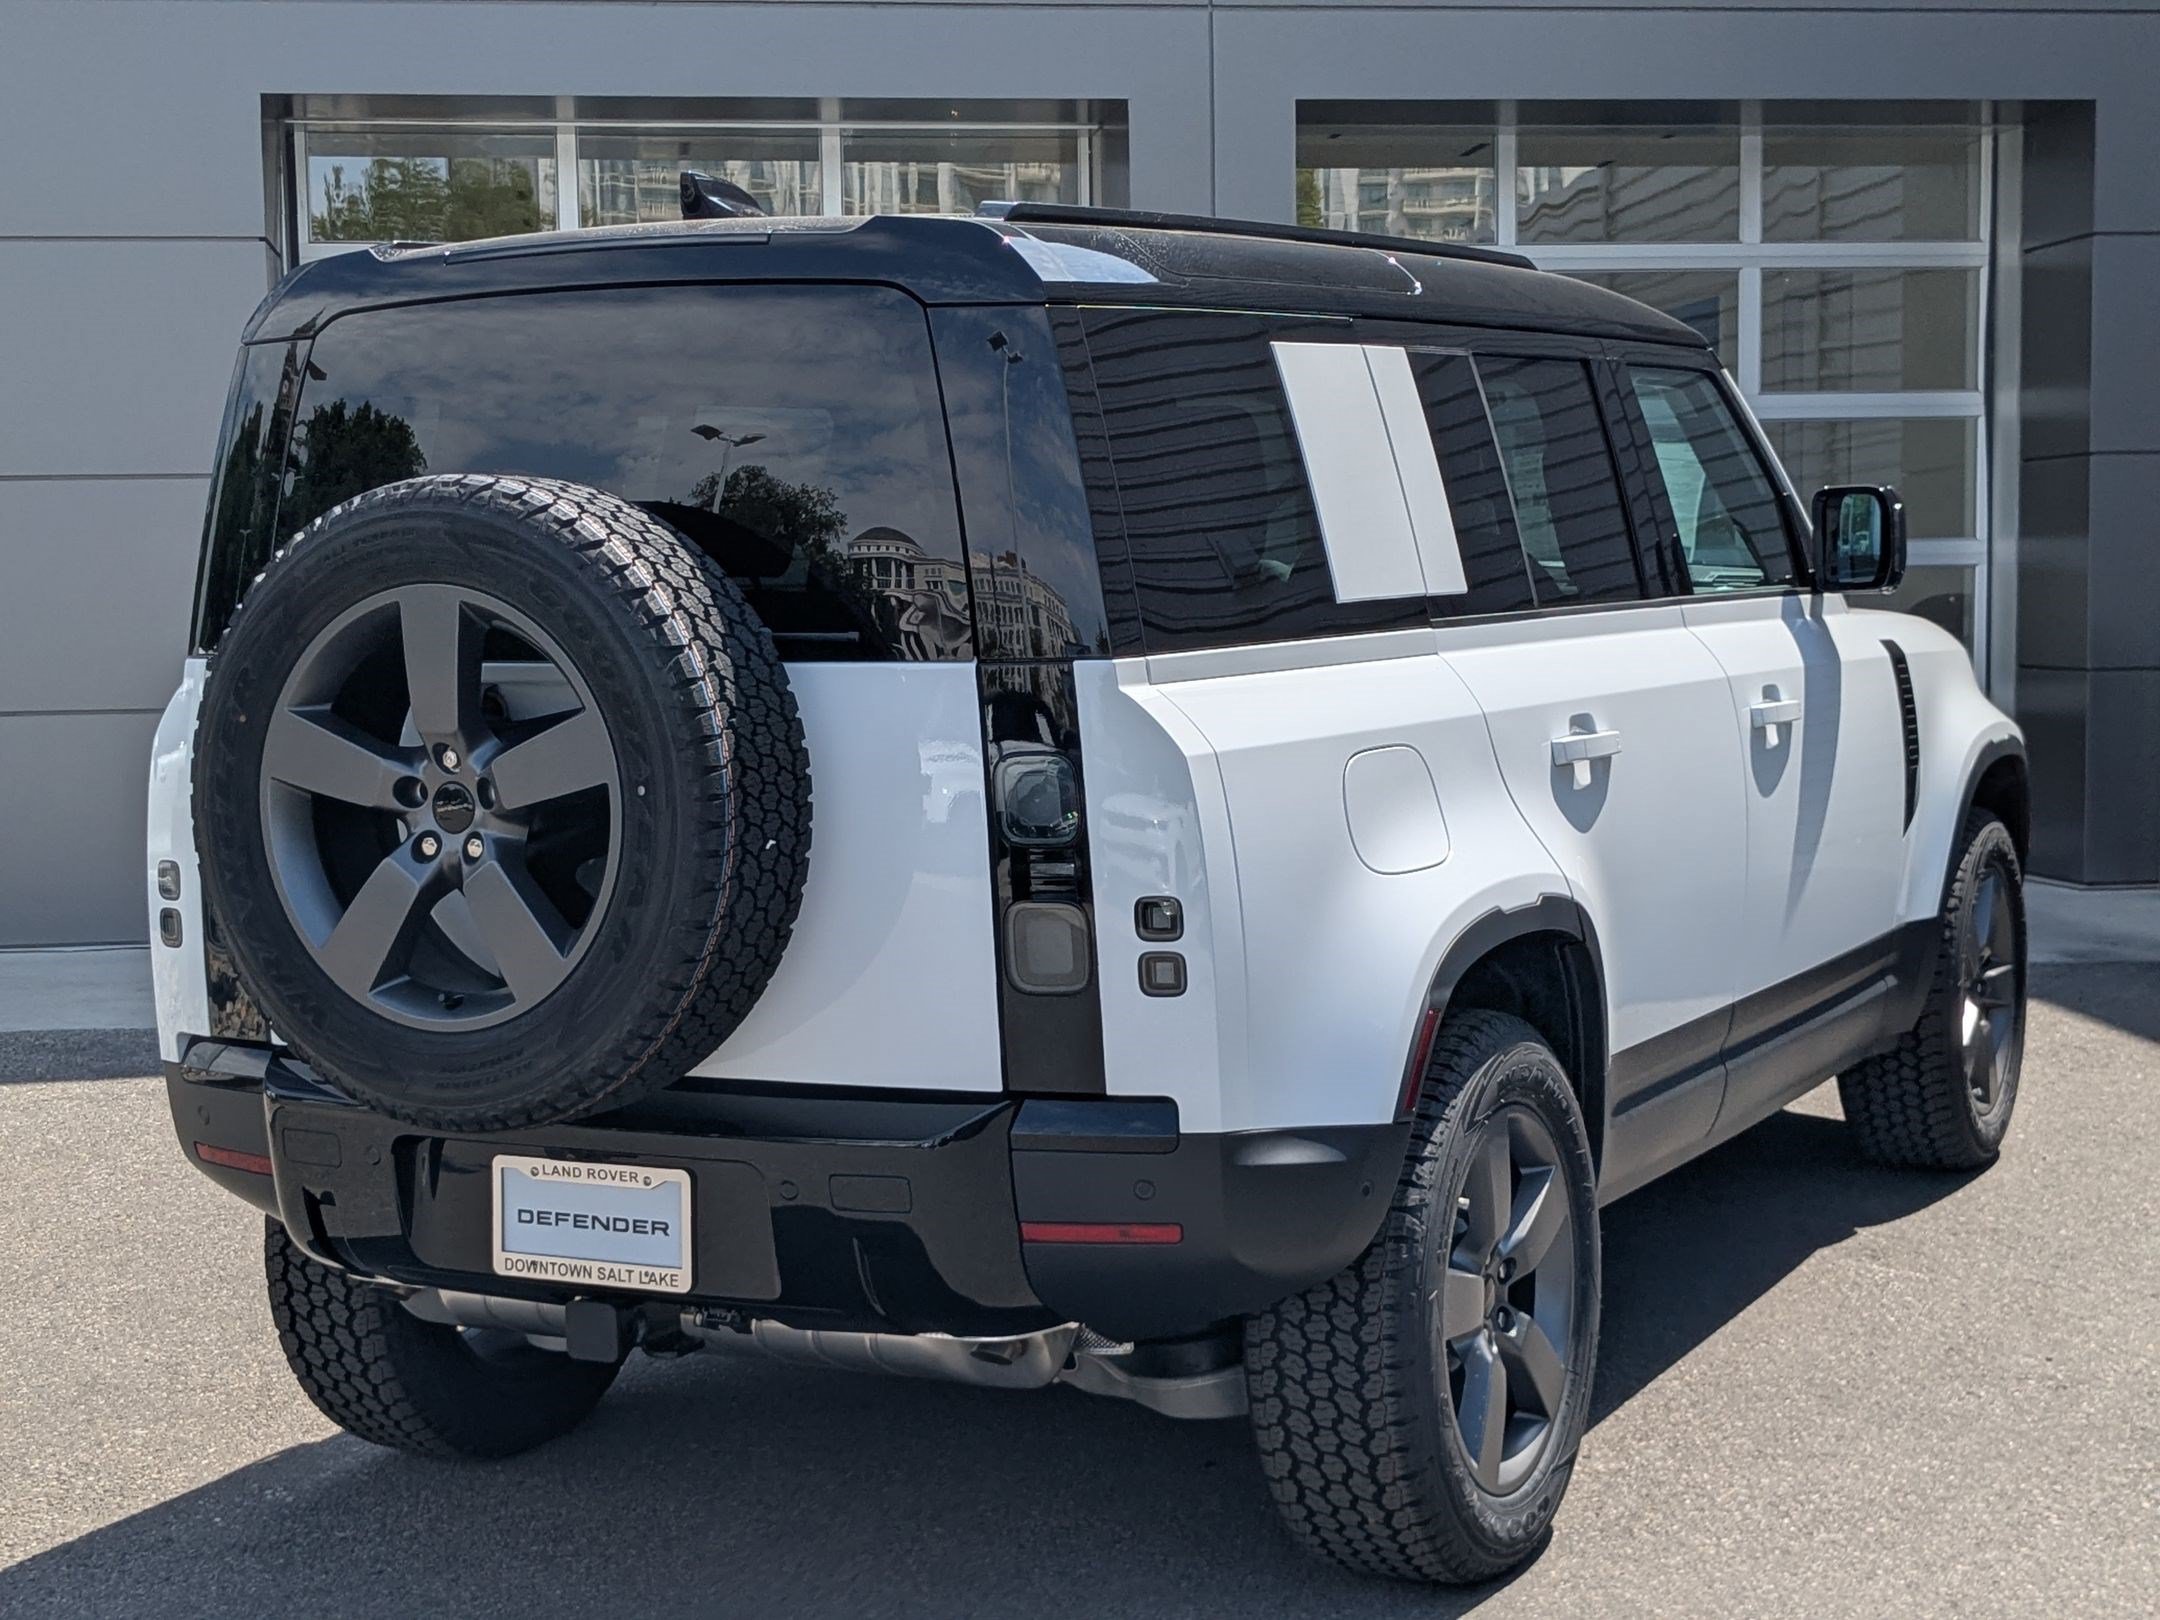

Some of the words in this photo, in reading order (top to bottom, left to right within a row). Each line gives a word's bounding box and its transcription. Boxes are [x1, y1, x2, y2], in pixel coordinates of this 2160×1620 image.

[542, 1164, 582, 1179] LAND
[587, 1168, 639, 1183] ROVER
[517, 1208, 670, 1237] DEFENDER
[504, 1257, 592, 1279] DOWNTOWN
[597, 1266, 635, 1284] SALT
[638, 1270, 679, 1288] LAKE
